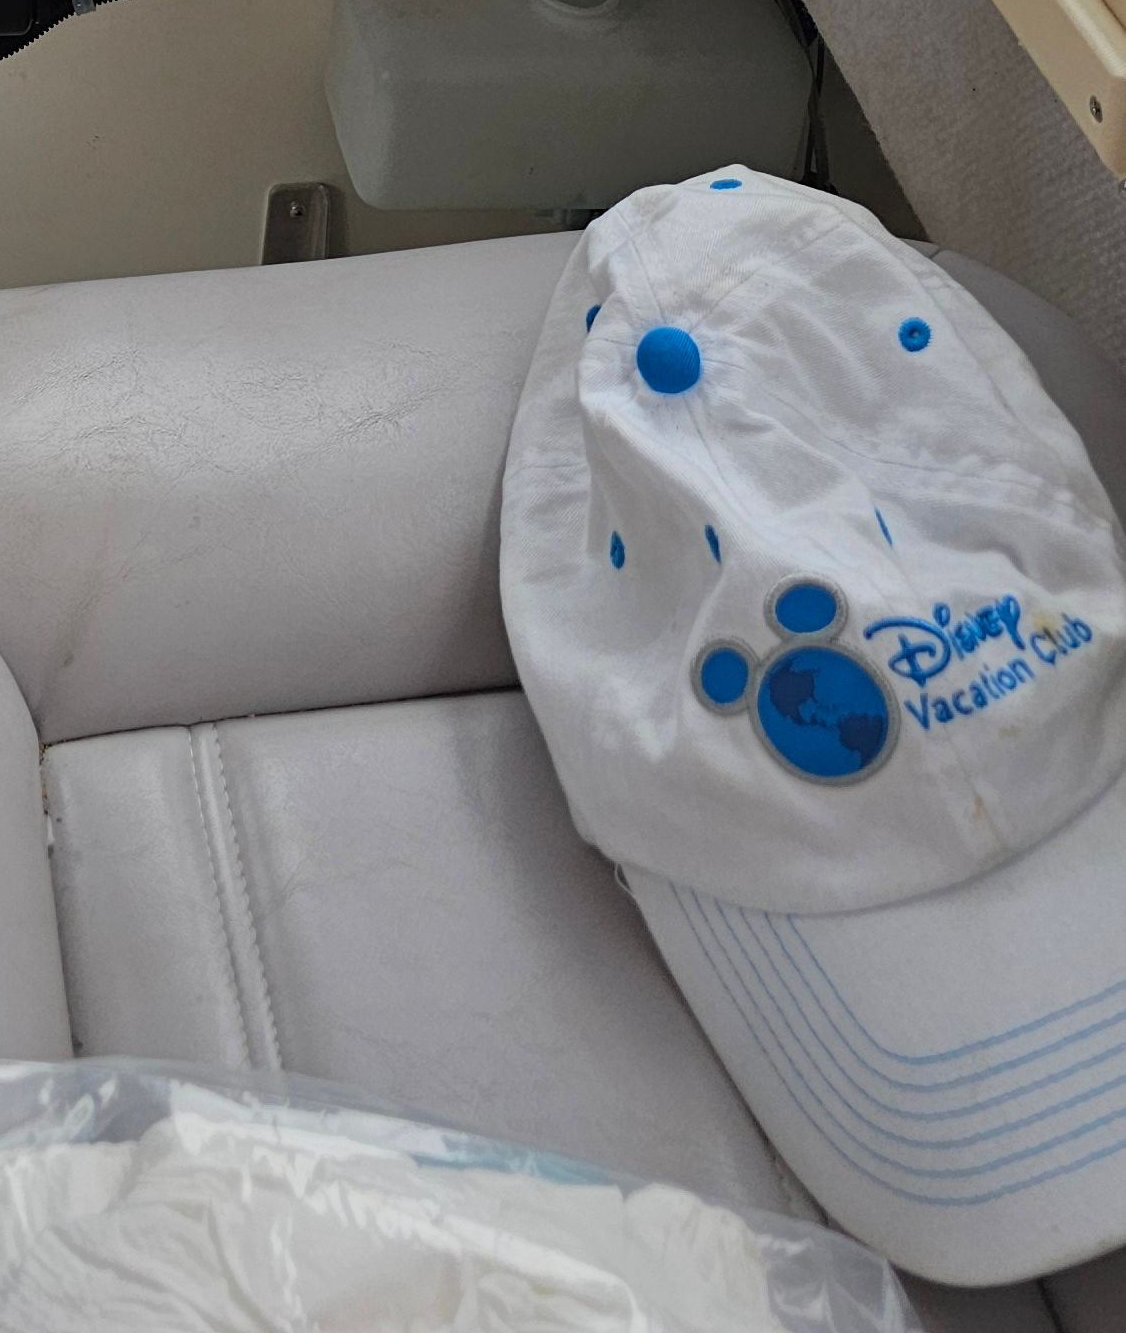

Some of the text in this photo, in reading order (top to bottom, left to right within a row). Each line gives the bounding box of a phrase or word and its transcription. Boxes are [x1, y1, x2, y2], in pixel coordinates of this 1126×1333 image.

[863, 593, 1026, 689] Disney
[904, 612, 1093, 731] Vacation Club
